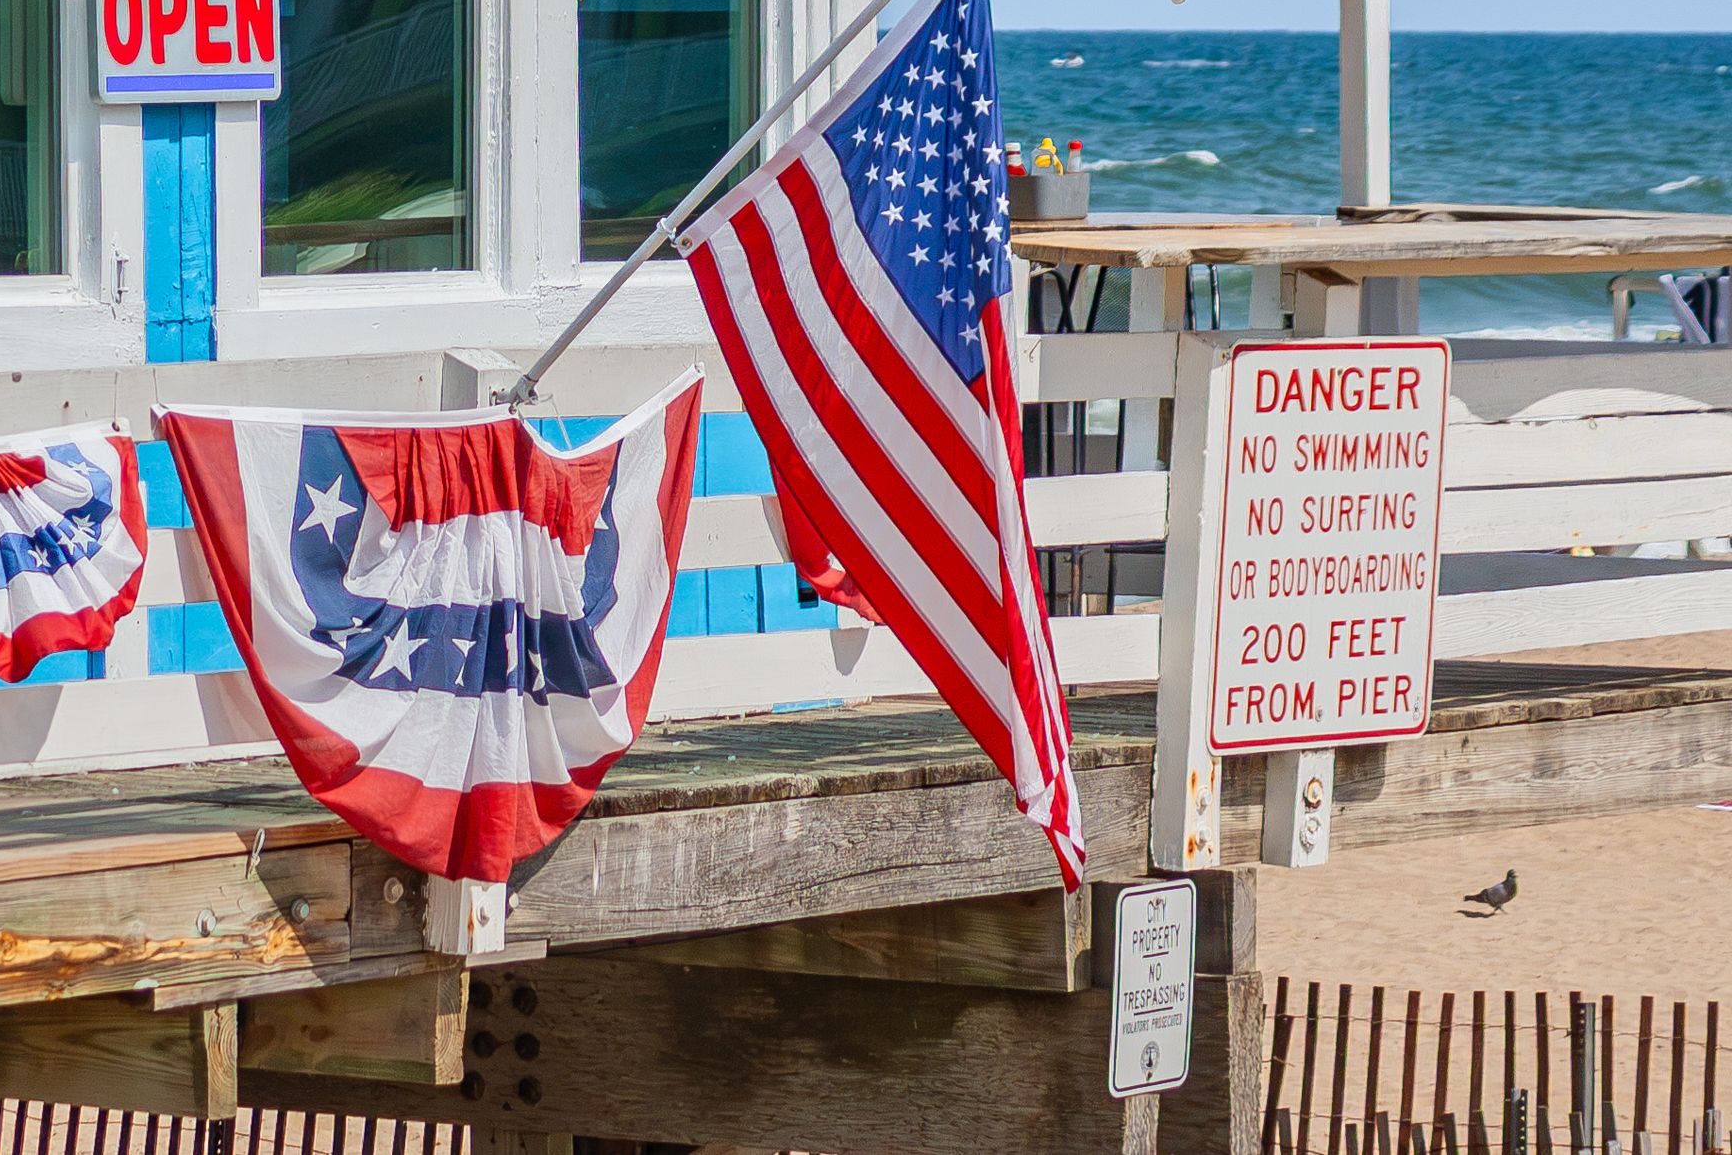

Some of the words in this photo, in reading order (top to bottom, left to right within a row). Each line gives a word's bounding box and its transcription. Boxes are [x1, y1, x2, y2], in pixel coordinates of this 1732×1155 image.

[1255, 366, 1421, 413] DANGER
[1241, 435, 1276, 474] NO
[1294, 430, 1429, 473] SWIMMING
[1247, 497, 1283, 536] NO
[1300, 492, 1416, 534] SURFING
[1230, 560, 1256, 601] OR
[1269, 552, 1426, 598] BODYBOARDING
[1241, 623, 1306, 665] 200
[1328, 616, 1406, 659] FEET
[1226, 681, 1315, 726] FROM
[1337, 674, 1412, 718] PIER
[1132, 923, 1181, 954] PROPERTY
[1149, 962, 1162, 983] NO
[1123, 982, 1185, 1012] TRESPASSING
